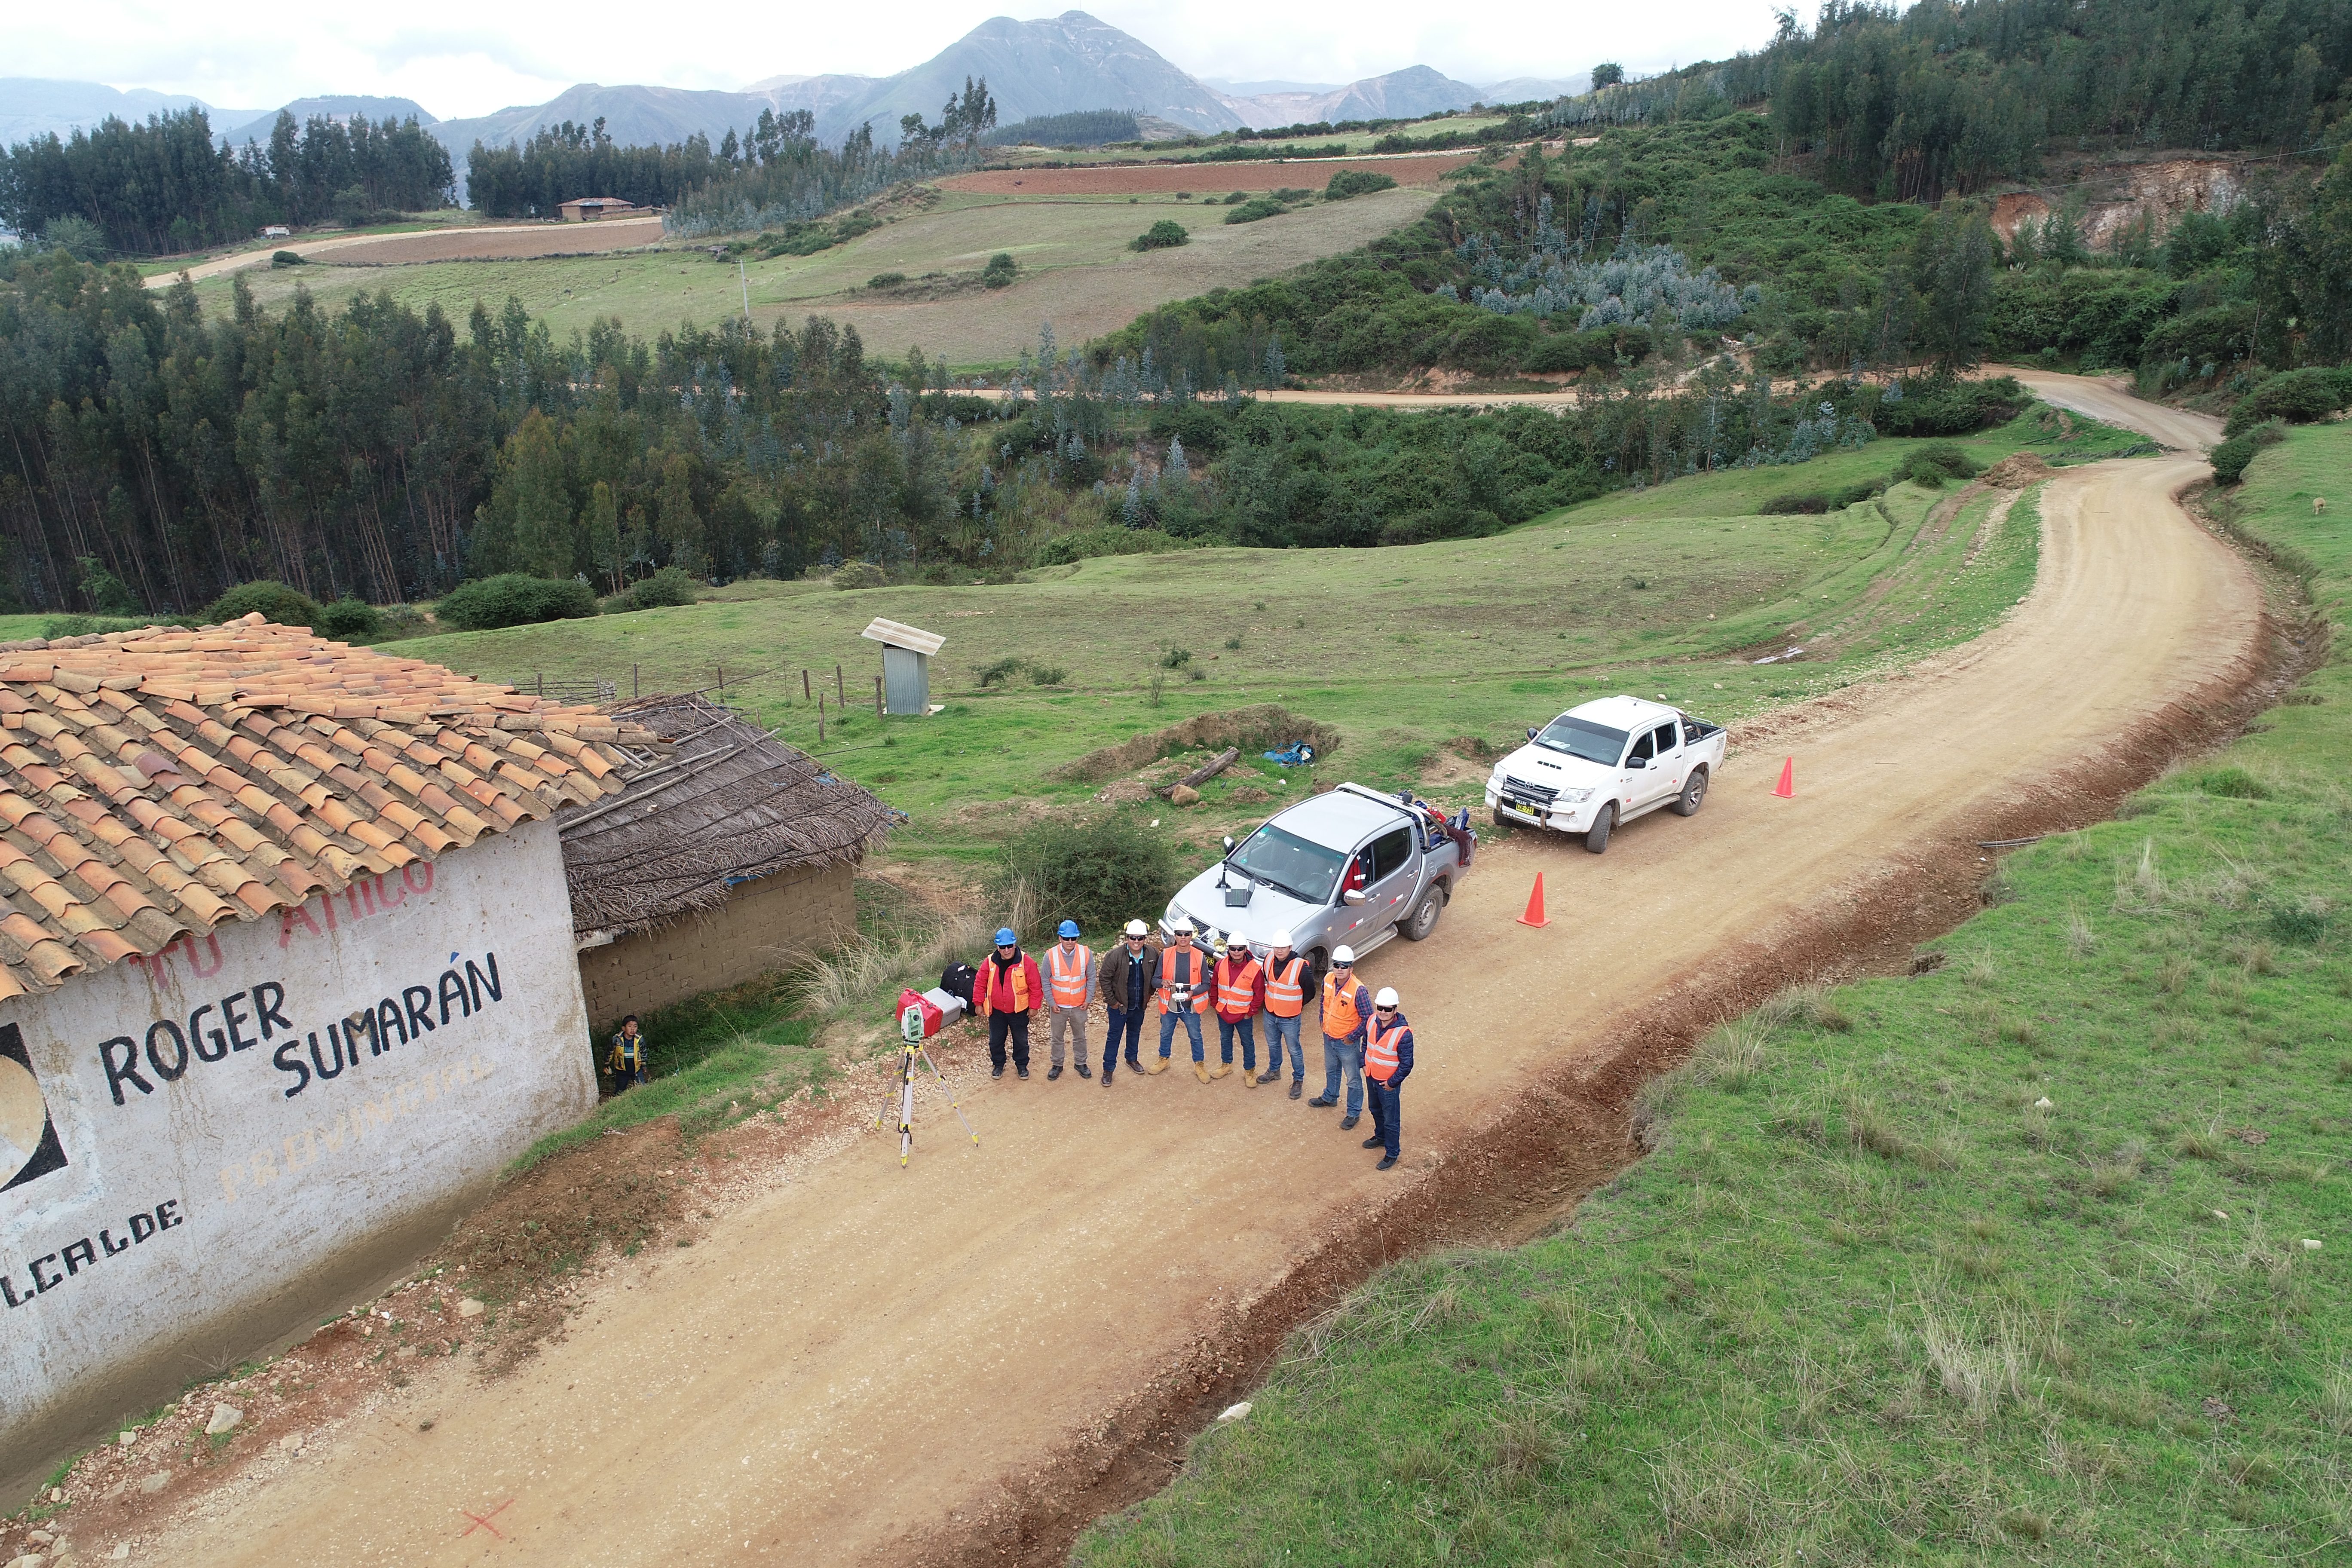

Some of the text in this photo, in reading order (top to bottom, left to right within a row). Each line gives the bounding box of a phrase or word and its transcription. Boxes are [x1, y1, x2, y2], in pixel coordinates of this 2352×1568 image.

[129, 932, 223, 989] TU
[1205, 956, 1214, 965] 783
[99, 981, 293, 1106] ROGER
[273, 952, 503, 1098] SUMARÁN
[0, 1054, 494, 1308] LCALDE PROVINCIAL
